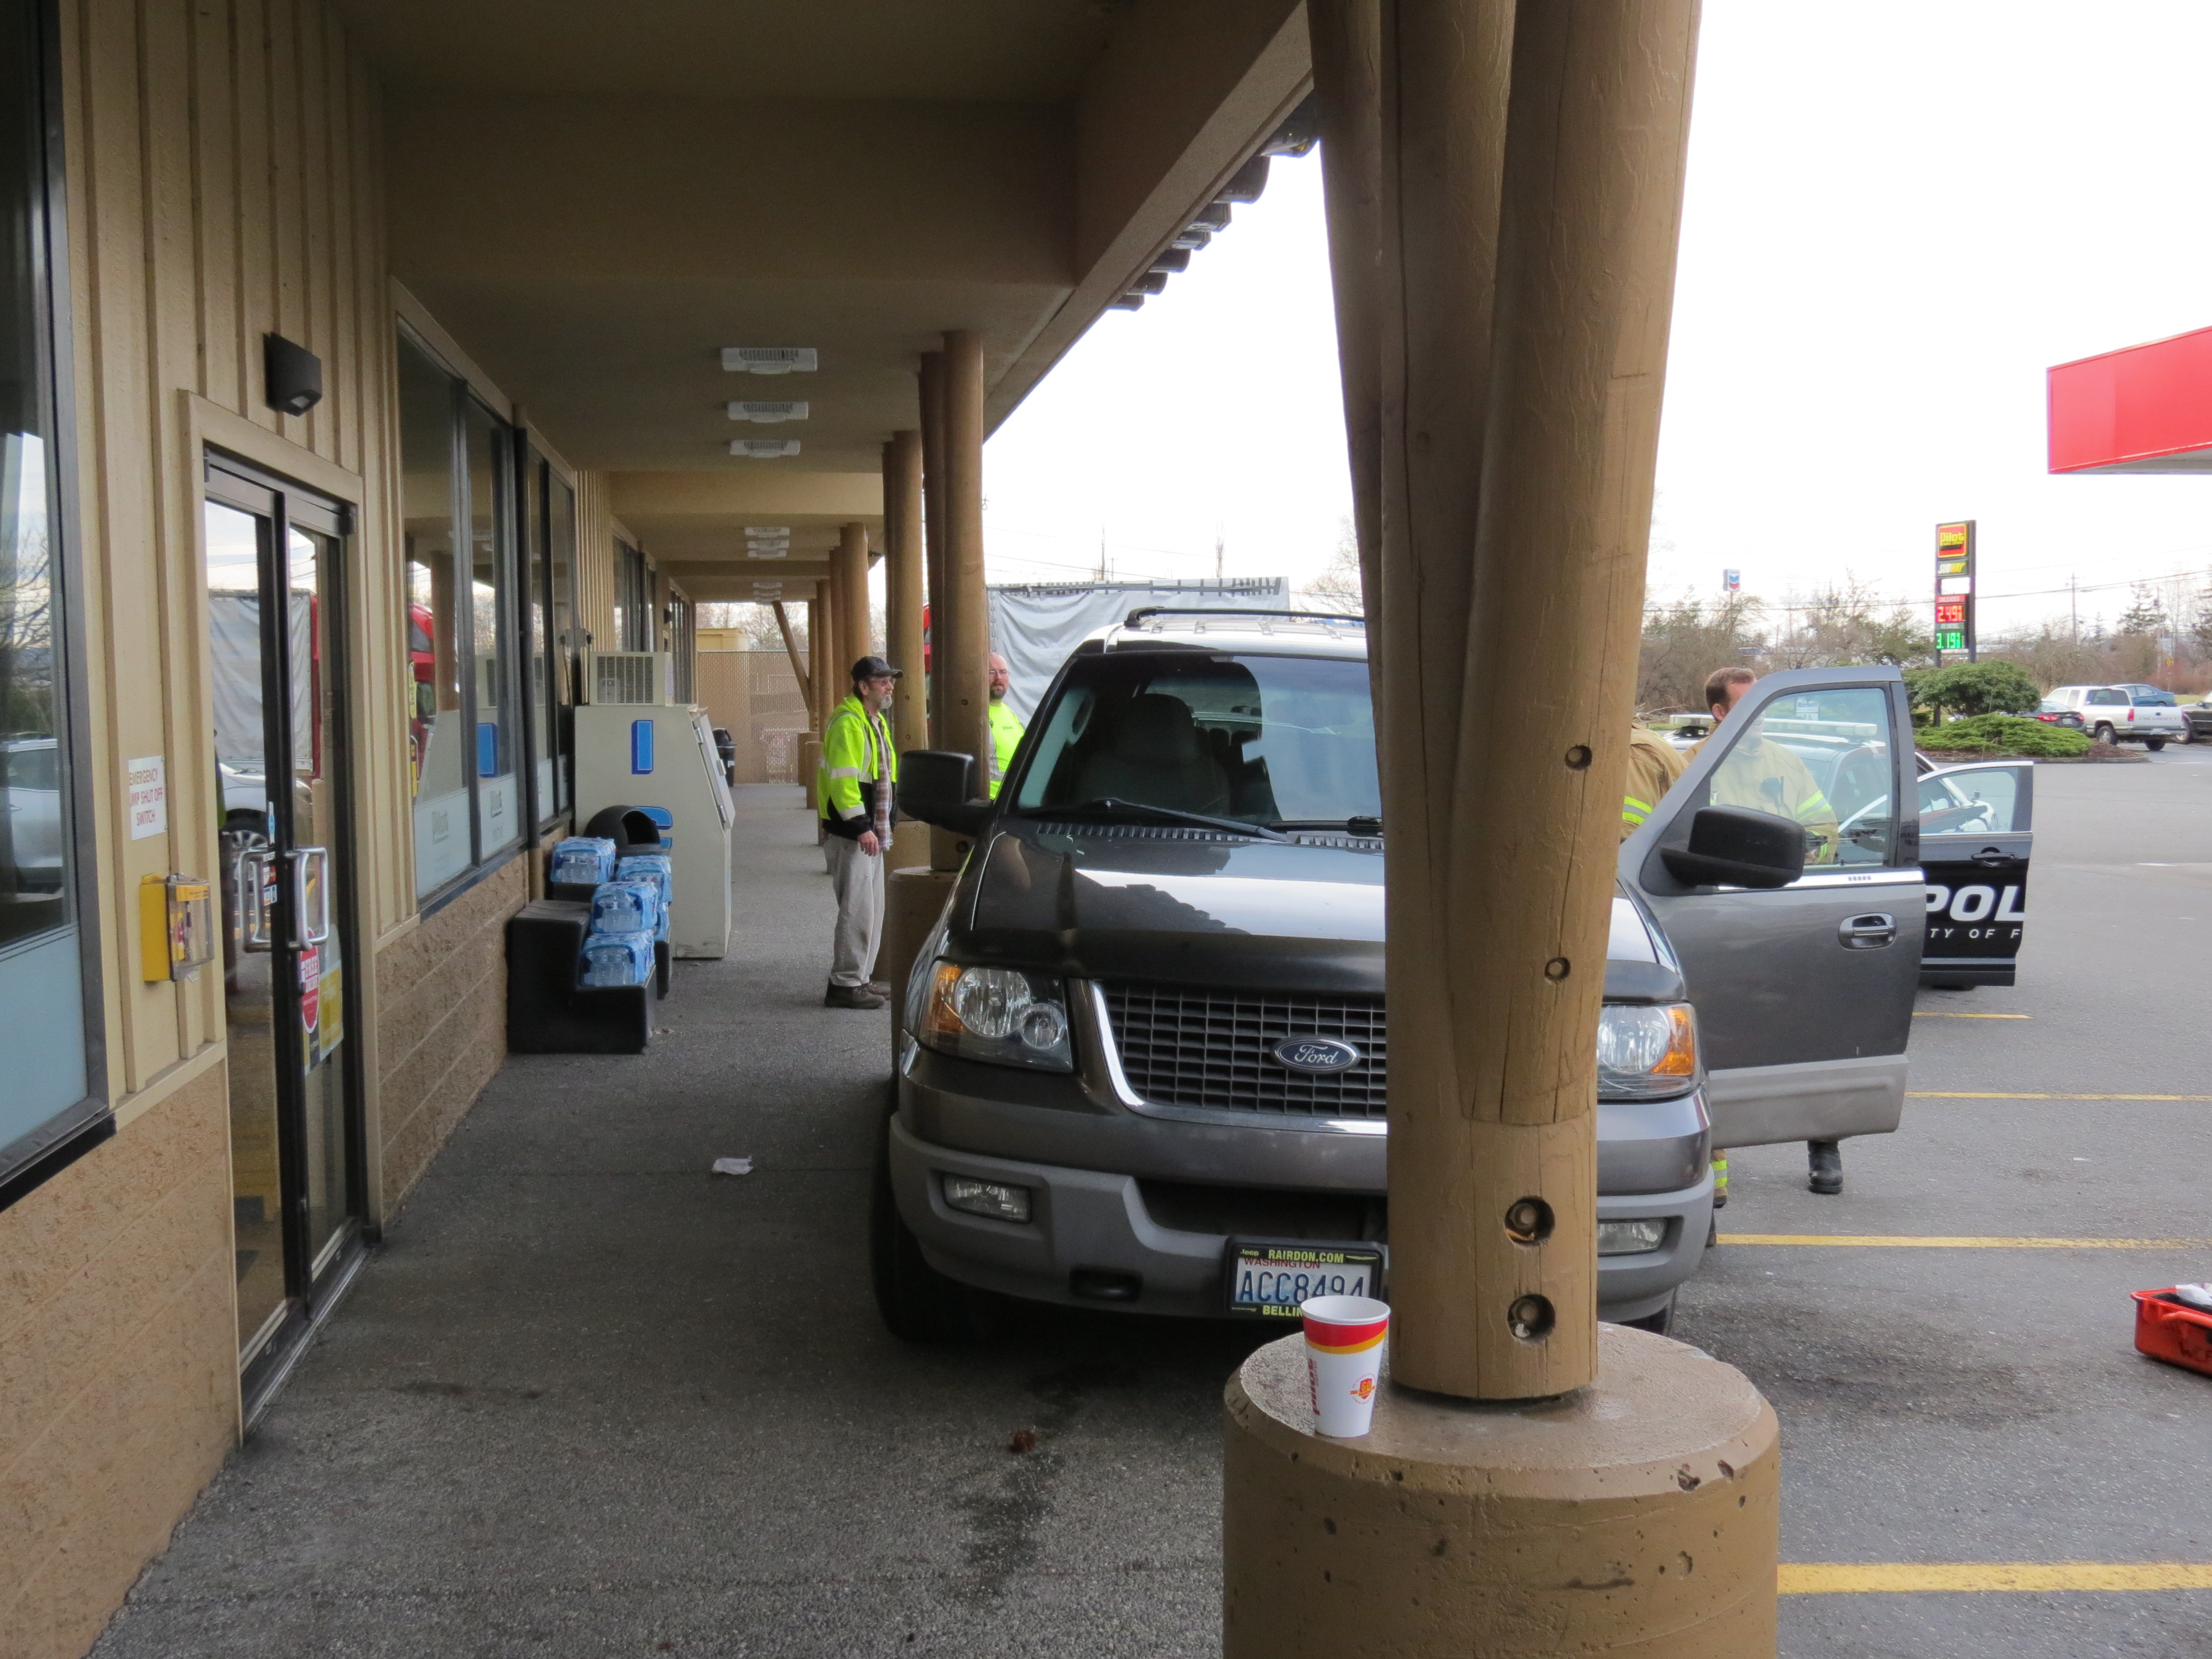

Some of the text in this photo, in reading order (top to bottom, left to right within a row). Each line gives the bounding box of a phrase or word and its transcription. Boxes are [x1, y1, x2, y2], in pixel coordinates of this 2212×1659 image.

[1939, 532, 1964, 546] Pilot
[1938, 562, 1966, 574] SUBWAY
[129, 768, 158, 786] EMERGENCY
[141, 789, 154, 805] SHUT
[154, 787, 163, 801] OFF
[137, 809, 156, 826] SWITCH
[1969, 928, 1995, 938] OF
[1294, 1044, 1339, 1064] Ford
[1268, 1249, 1344, 1263] RAIRDON.COM
[1240, 1270, 1364, 1304] ACC8494
